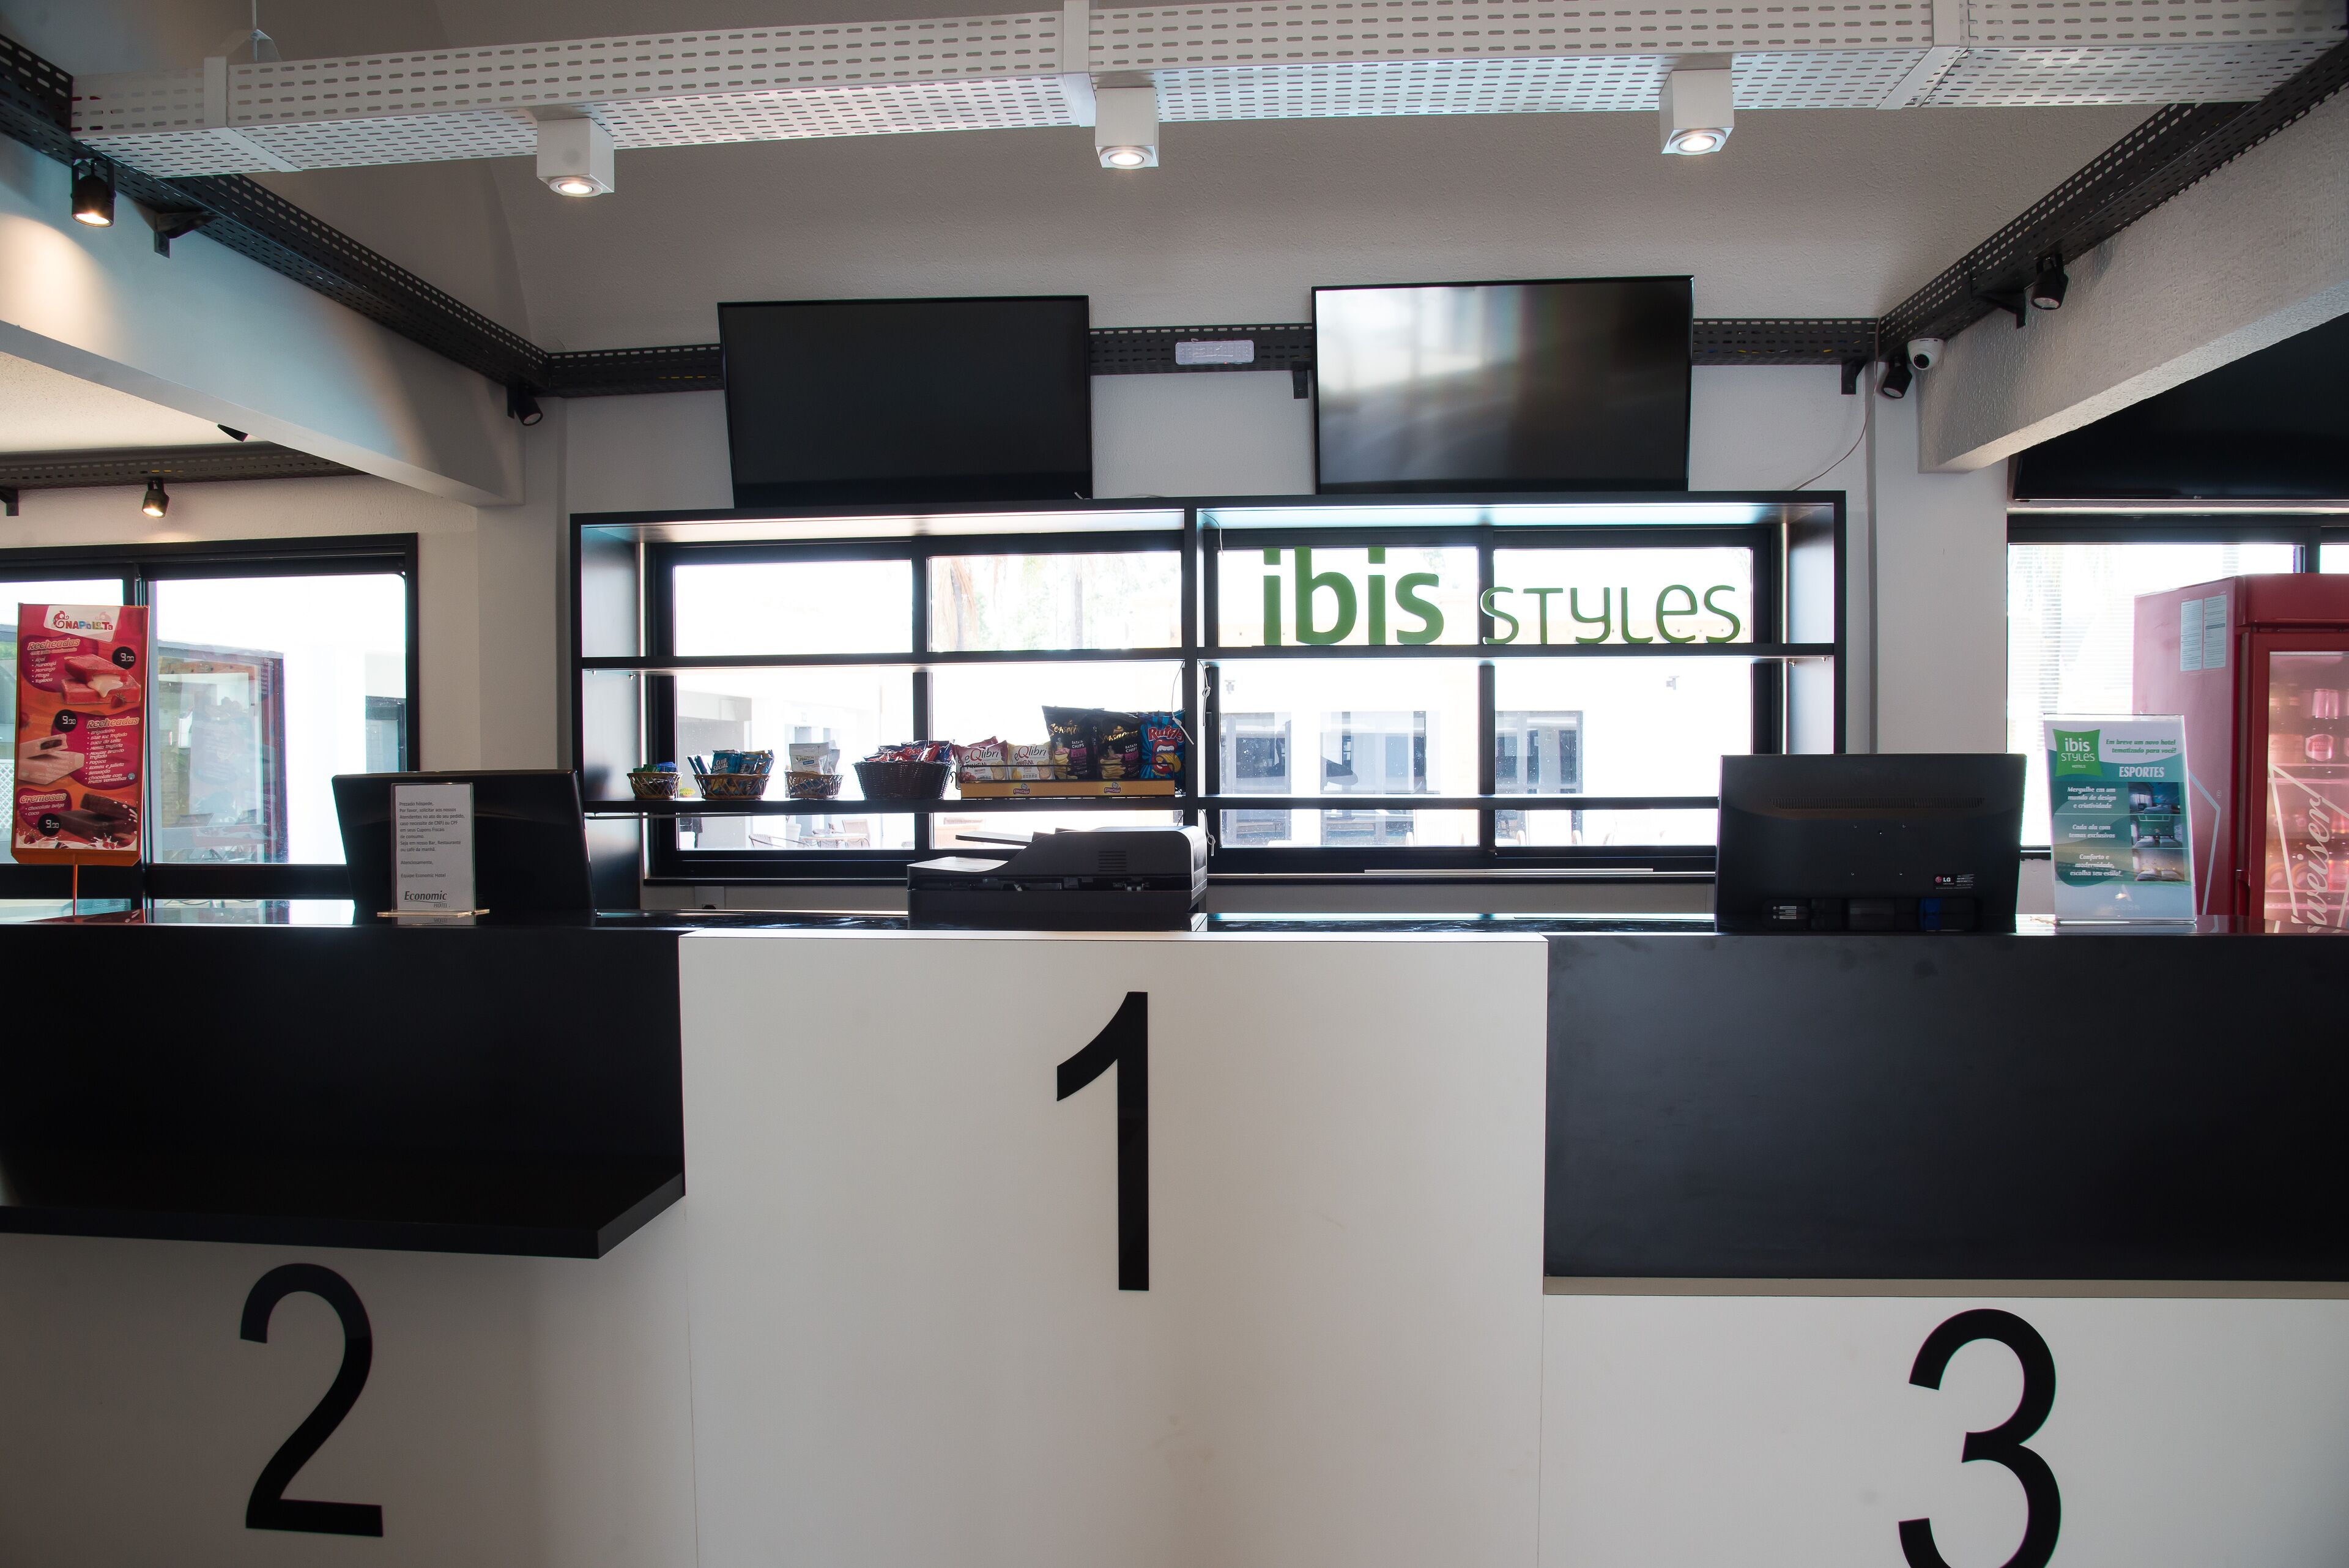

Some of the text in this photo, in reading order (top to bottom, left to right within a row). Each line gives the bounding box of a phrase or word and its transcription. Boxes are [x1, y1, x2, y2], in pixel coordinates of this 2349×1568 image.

[1263, 547, 1444, 645] ibis
[28, 637, 80, 650] Recheadas
[86, 716, 139, 729] Recheadas
[2065, 738, 2090, 752] ibis
[1014, 745, 1048, 761] eQlibri
[713, 762, 728, 771] SOCIAL
[2119, 767, 2164, 777] ESPORTES
[2297, 796, 2330, 925] weiser
[404, 891, 447, 900] Economic
[1057, 992, 1149, 1291] 1
[240, 1263, 384, 1537] 2
[1898, 1309, 2061, 1568] 3
